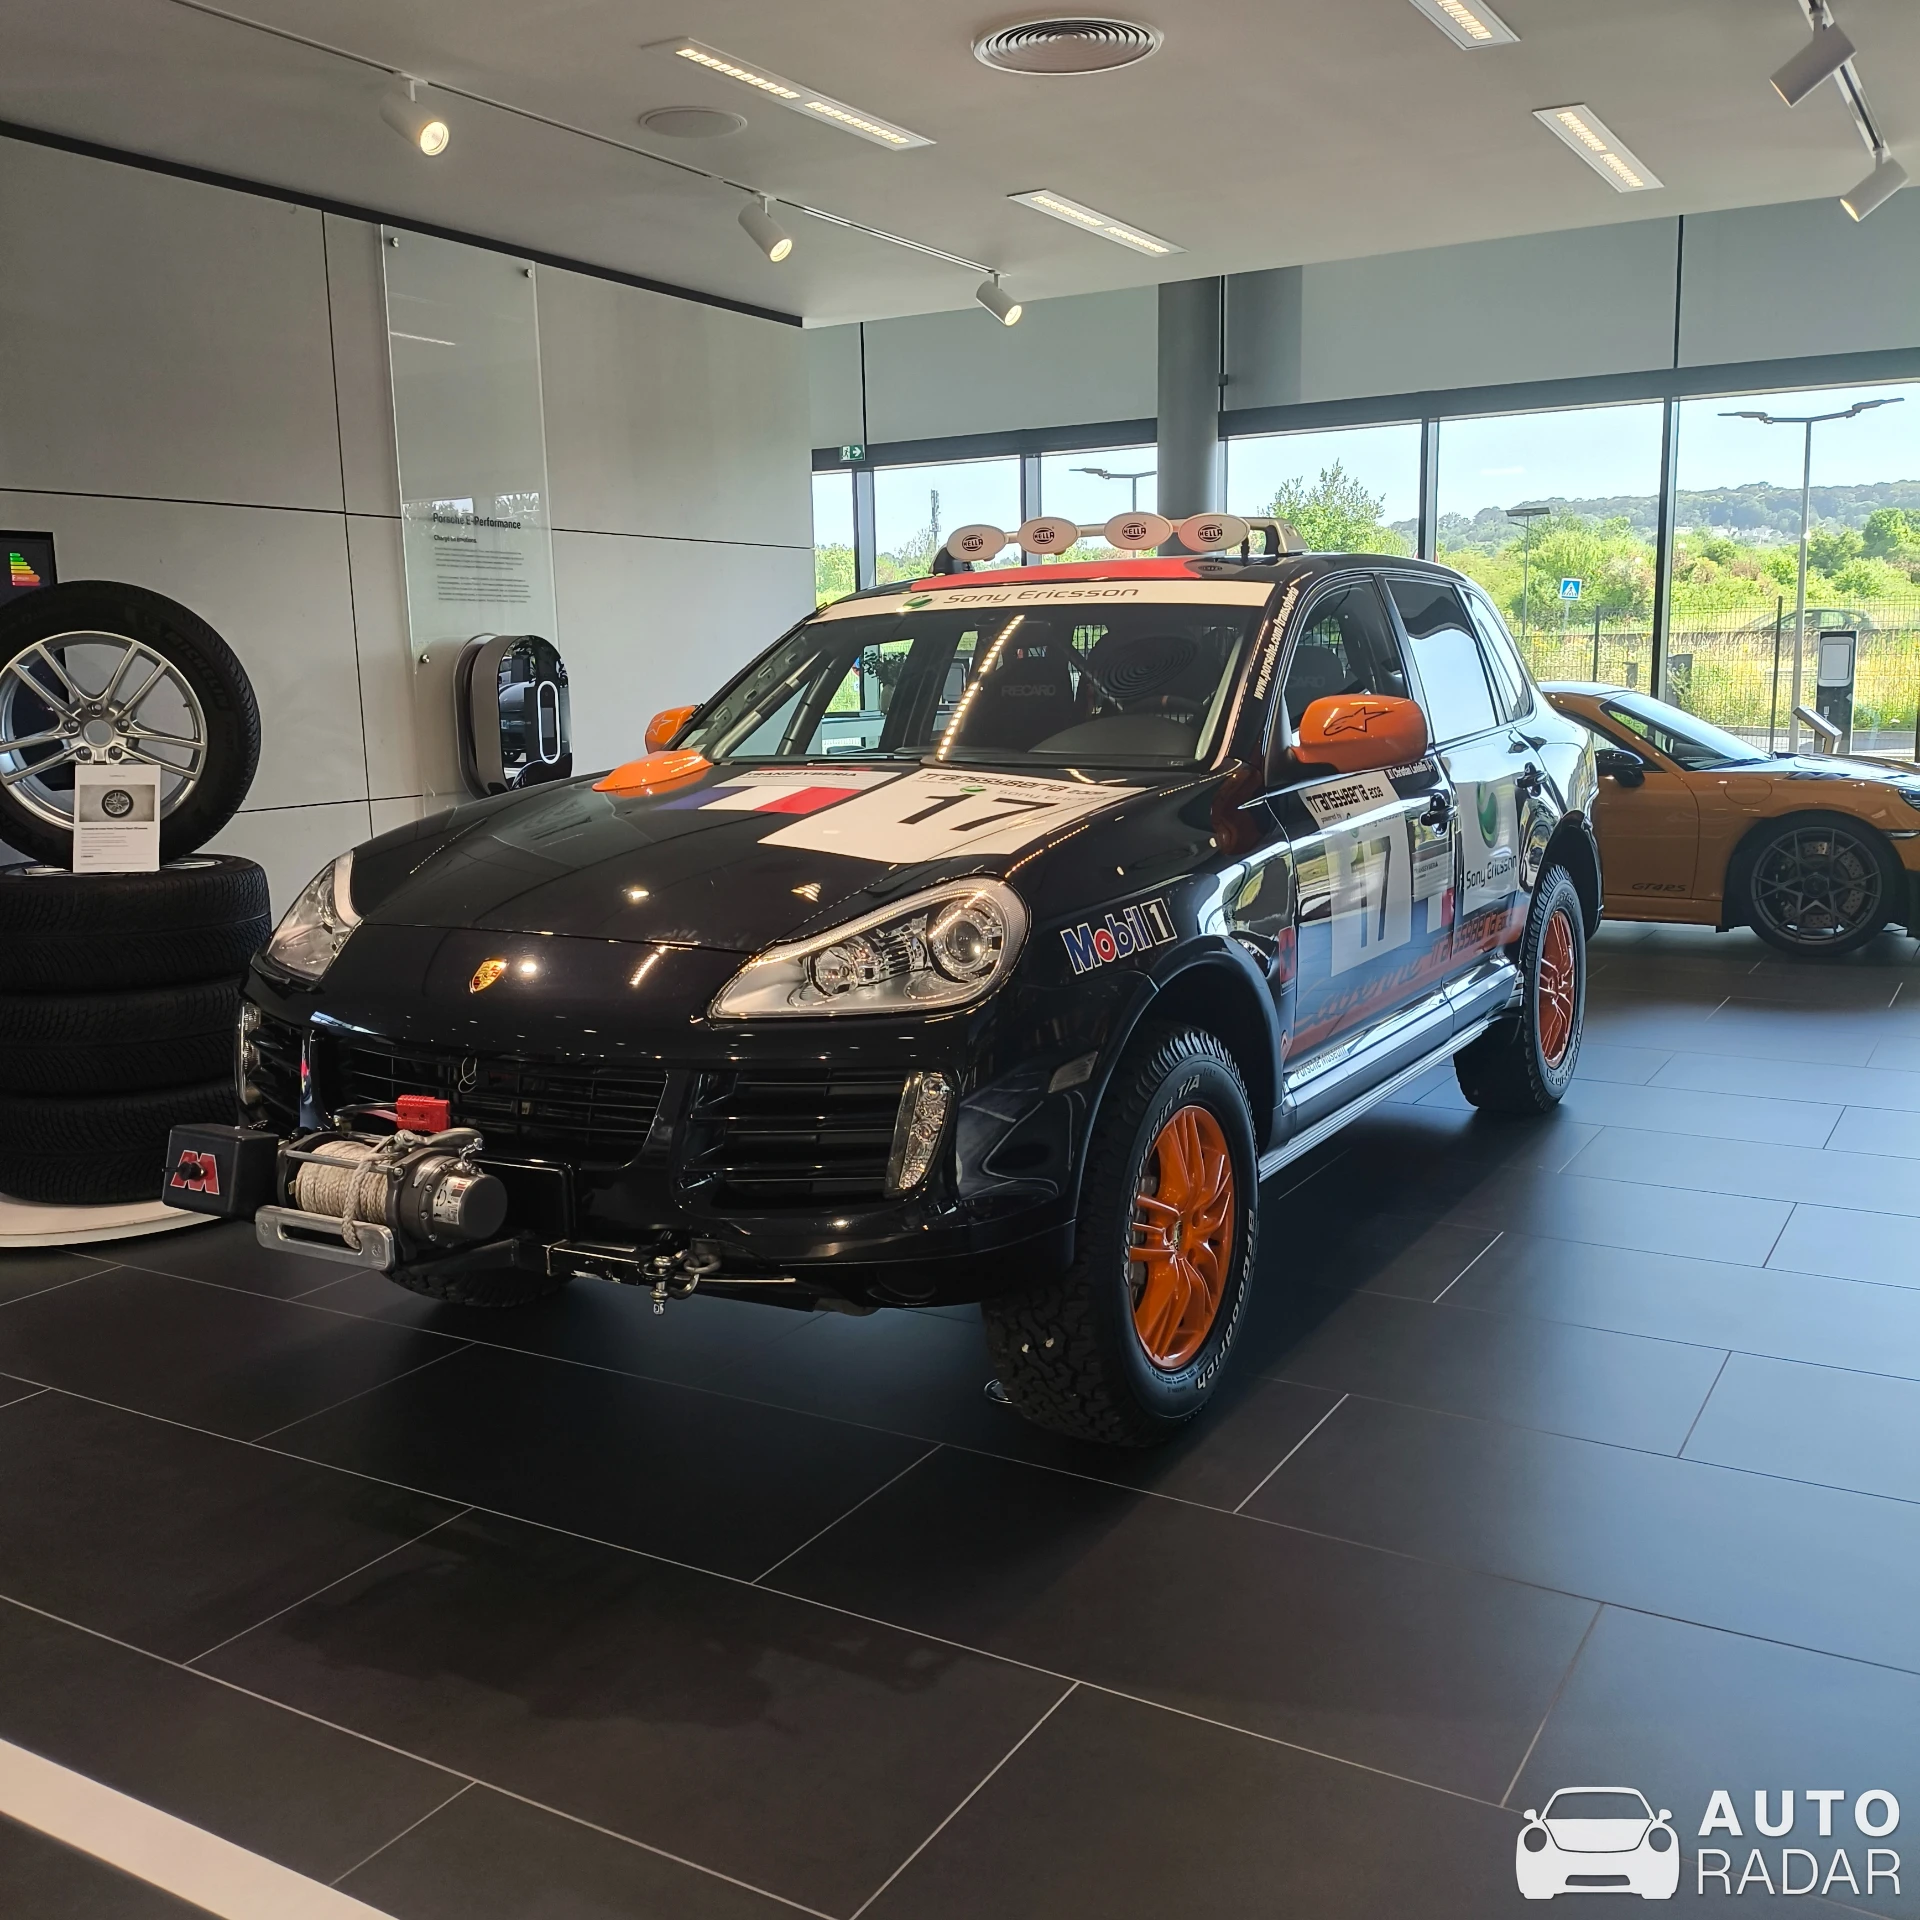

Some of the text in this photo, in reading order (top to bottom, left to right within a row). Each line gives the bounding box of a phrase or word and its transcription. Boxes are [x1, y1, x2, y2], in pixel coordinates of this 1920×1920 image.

[433, 513, 522, 530] Porsche E-Performance
[943, 588, 1139, 604] Sony Ericsson
[1367, 786, 1384, 799] 2008
[897, 794, 1060, 832] 17
[1466, 855, 1518, 890] Sony Ericsson
[1350, 835, 1392, 949] 17
[1060, 906, 1153, 975] Mobil
[1196, 1208, 1256, 1391] BFGoodrich
